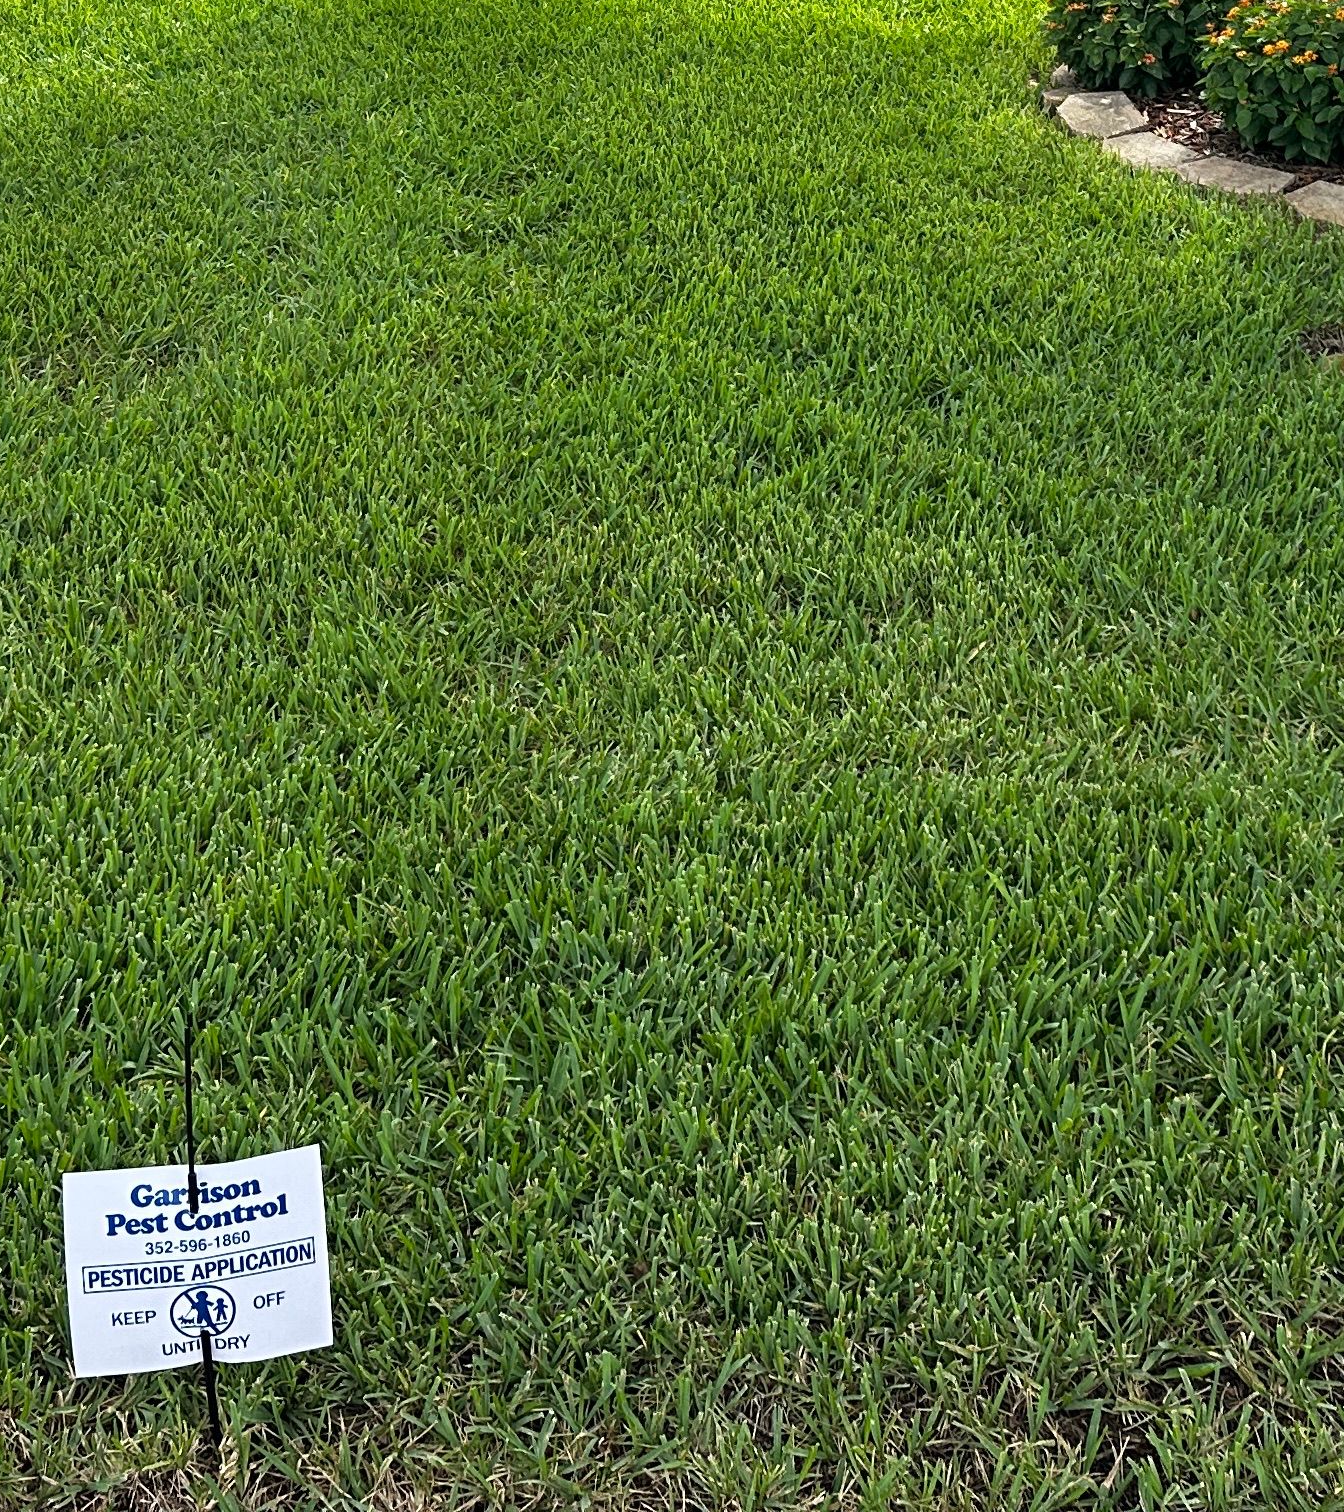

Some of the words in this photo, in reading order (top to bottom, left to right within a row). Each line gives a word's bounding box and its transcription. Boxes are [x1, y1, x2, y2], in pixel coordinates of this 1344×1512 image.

[130, 1179, 262, 1208] Garison
[106, 1213, 169, 1236] Pest
[174, 1194, 289, 1232] Control
[145, 1230, 251, 1255] 352-596-1860
[88, 1265, 186, 1288] PESTICIDE
[191, 1242, 312, 1282] APPLICATION
[111, 1310, 157, 1326] KEEP
[253, 1291, 286, 1309] OFF
[162, 1338, 205, 1356] UNTI
[214, 1334, 251, 1350] DRY
